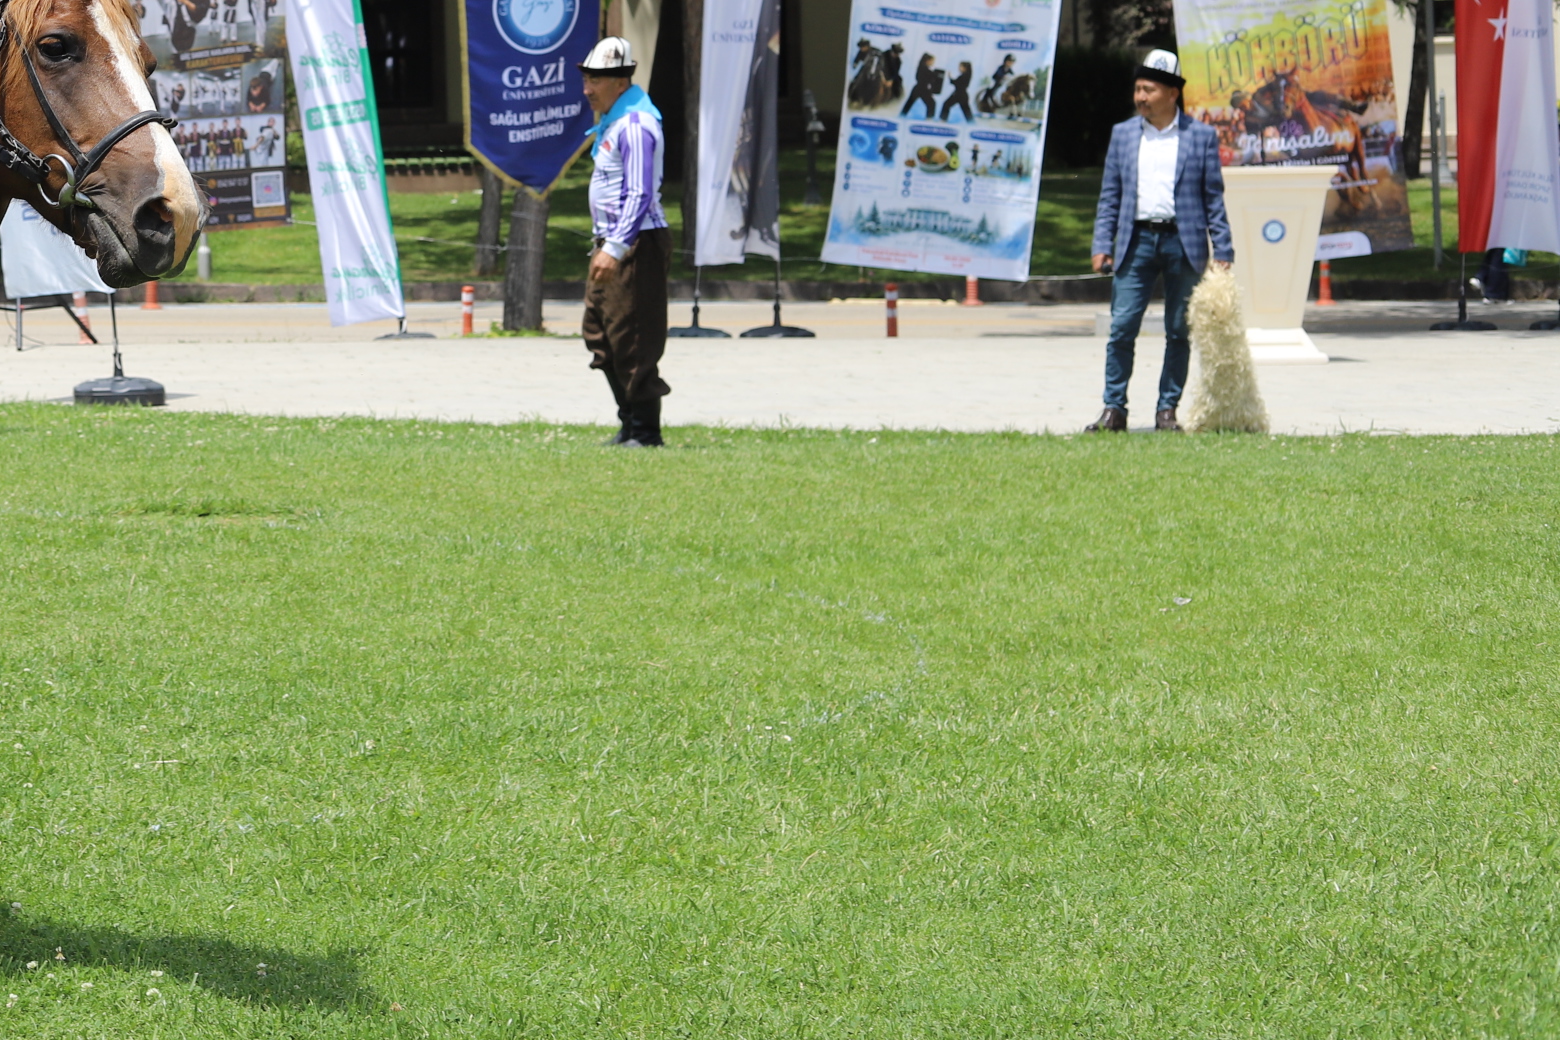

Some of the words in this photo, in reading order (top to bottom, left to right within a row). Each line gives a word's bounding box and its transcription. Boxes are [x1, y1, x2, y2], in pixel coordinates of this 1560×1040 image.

[1206, 0, 1369, 94] KÖKBÖRÜ
[502, 56, 565, 89] GAZİ
[502, 83, 566, 101] ÜNİVERSİTESİ
[489, 109, 532, 126] SAĞLIK
[533, 101, 582, 123] BİLİMLERİ
[508, 120, 564, 143] ENSTİTÜSÜ
